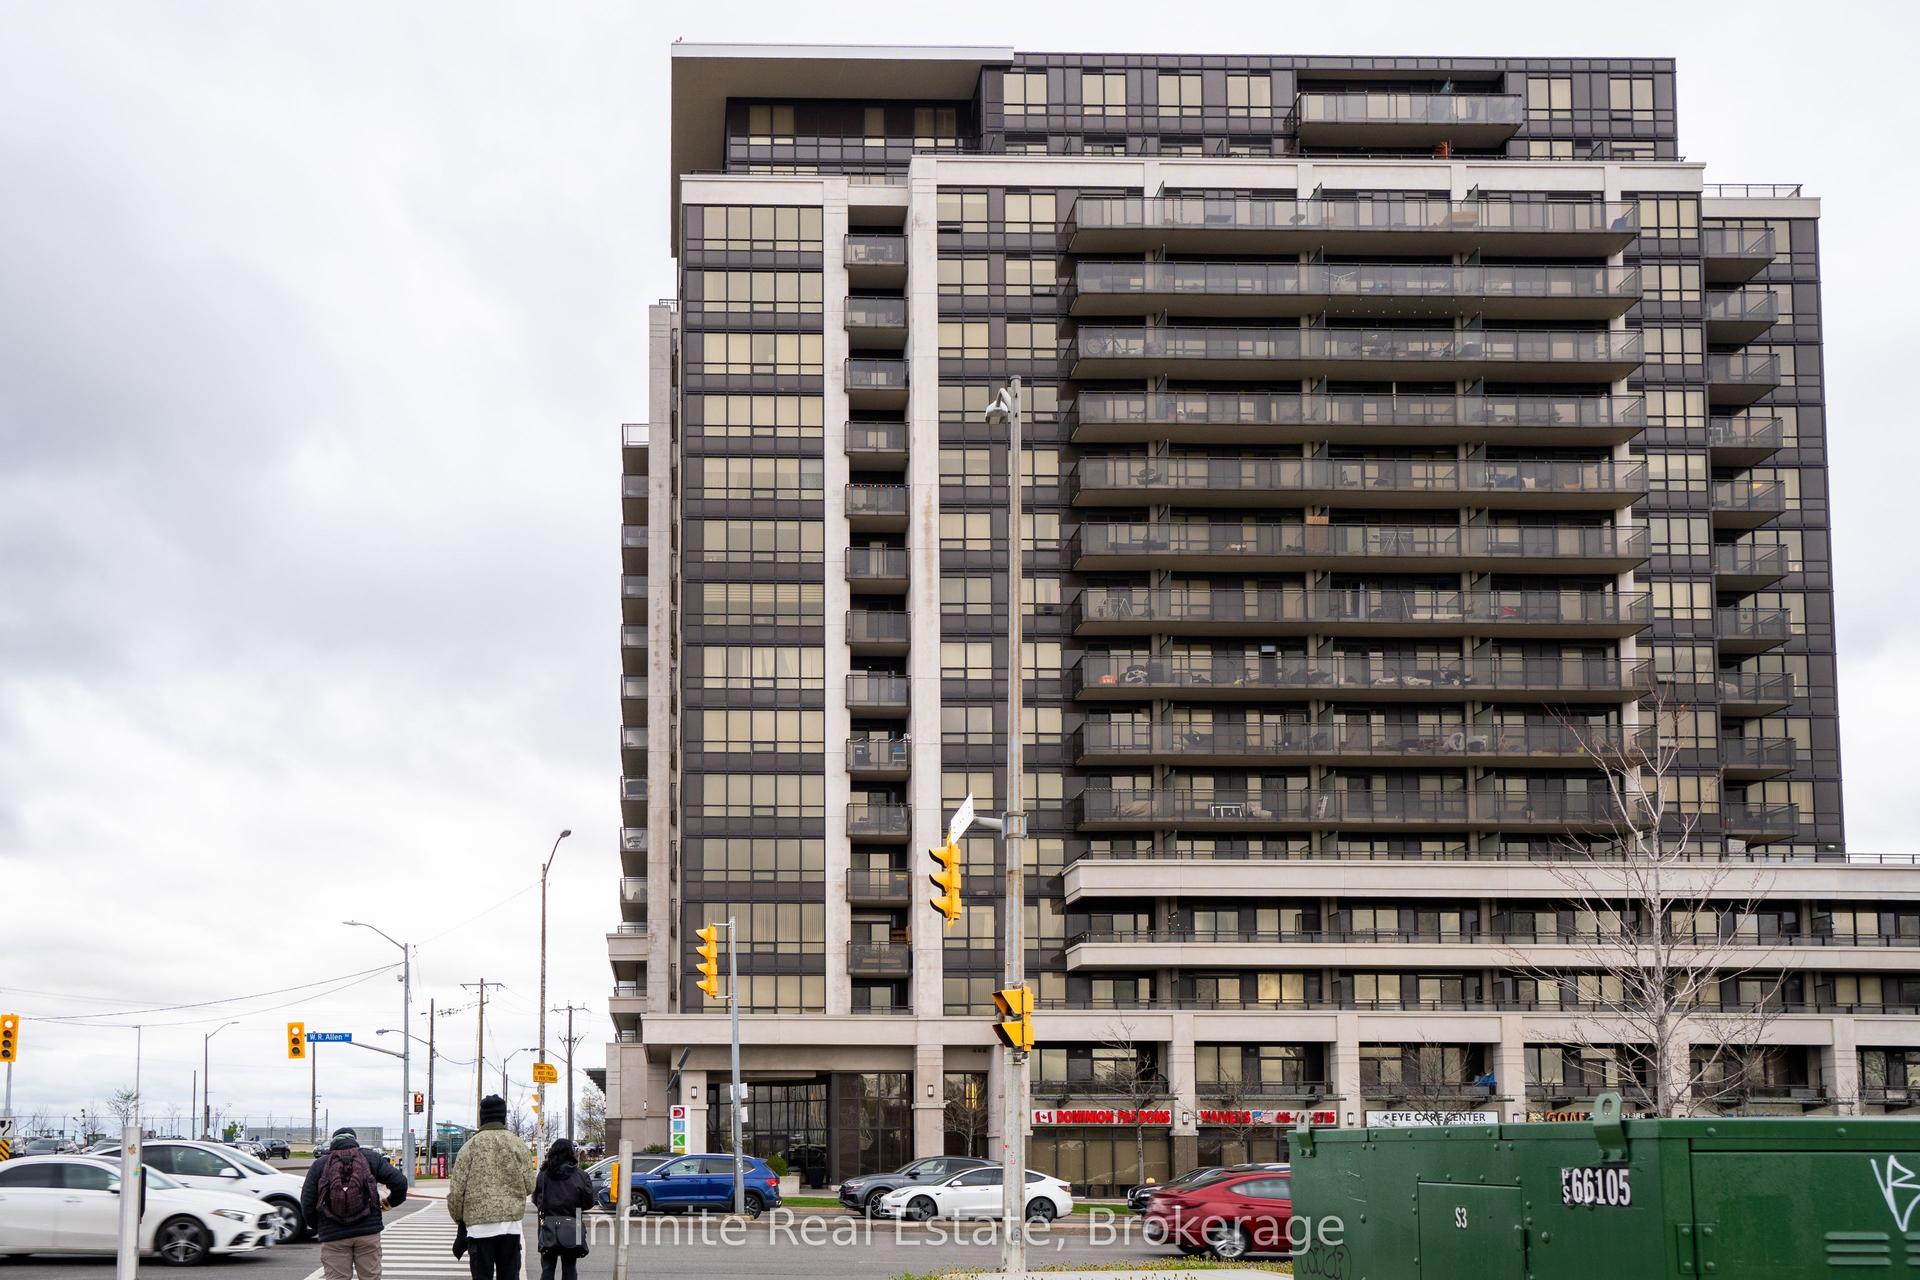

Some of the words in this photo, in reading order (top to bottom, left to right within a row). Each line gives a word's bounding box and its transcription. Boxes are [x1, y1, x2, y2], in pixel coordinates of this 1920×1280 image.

[1056, 1110, 1114, 1124] DOMINION
[1391, 1113, 1411, 1121] EYE
[1414, 1113, 1444, 1121] CARE
[1446, 1113, 1486, 1121] CENTER
[1571, 1168, 1631, 1206] 66105
[1455, 1207, 1467, 1228] S3
